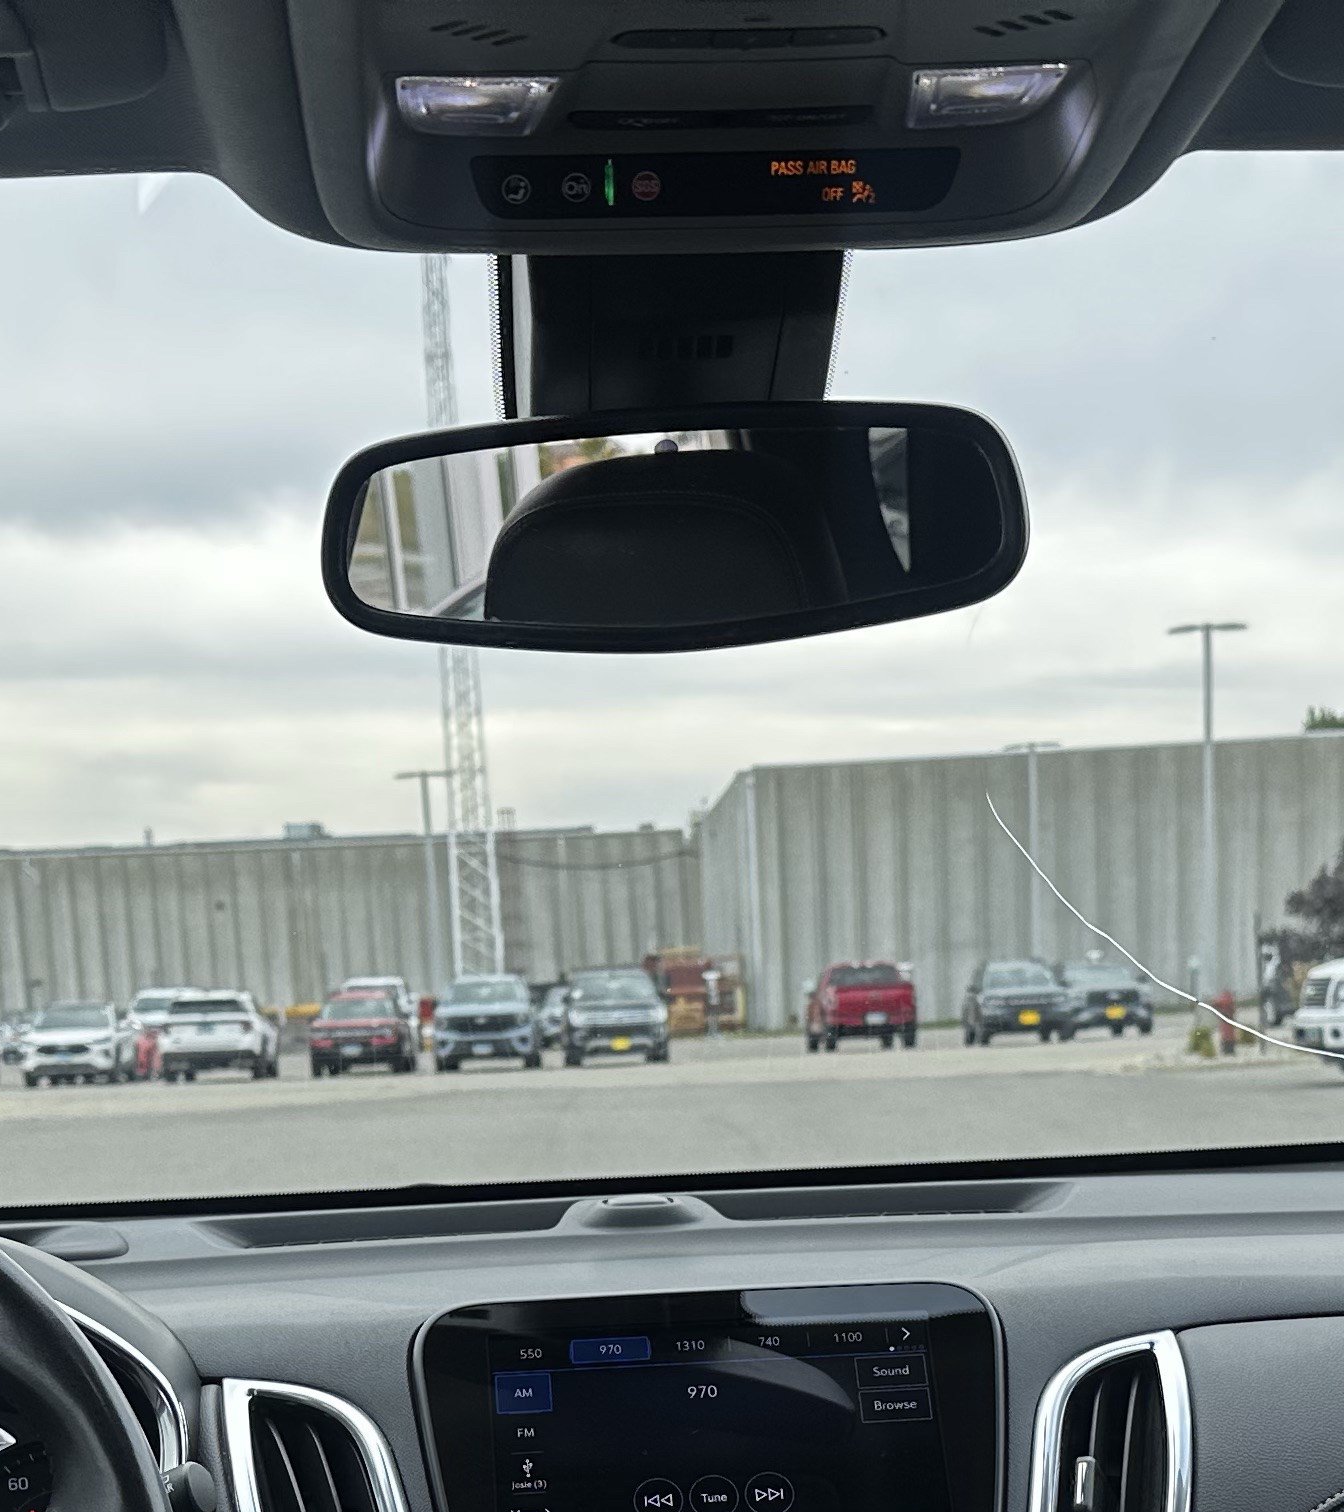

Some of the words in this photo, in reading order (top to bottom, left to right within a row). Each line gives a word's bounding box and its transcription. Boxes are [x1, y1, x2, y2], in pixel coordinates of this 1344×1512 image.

[770, 160, 804, 176] PASS
[807, 160, 828, 175] AIR
[830, 159, 857, 175] BAG
[821, 186, 845, 201] OFF
[757, 1336, 780, 1347] 740
[833, 1331, 863, 1343] 1100
[599, 1344, 622, 1356] 970
[675, 1339, 705, 1352] 1310
[519, 1348, 543, 1360] 550
[872, 1364, 910, 1377] Sound
[514, 1387, 533, 1398] AM
[687, 1384, 718, 1399] 970
[874, 1400, 918, 1411] Browse
[516, 1427, 535, 1438] FM
[7, 1475, 29, 1492] 60
[700, 1493, 728, 1504] Tune
